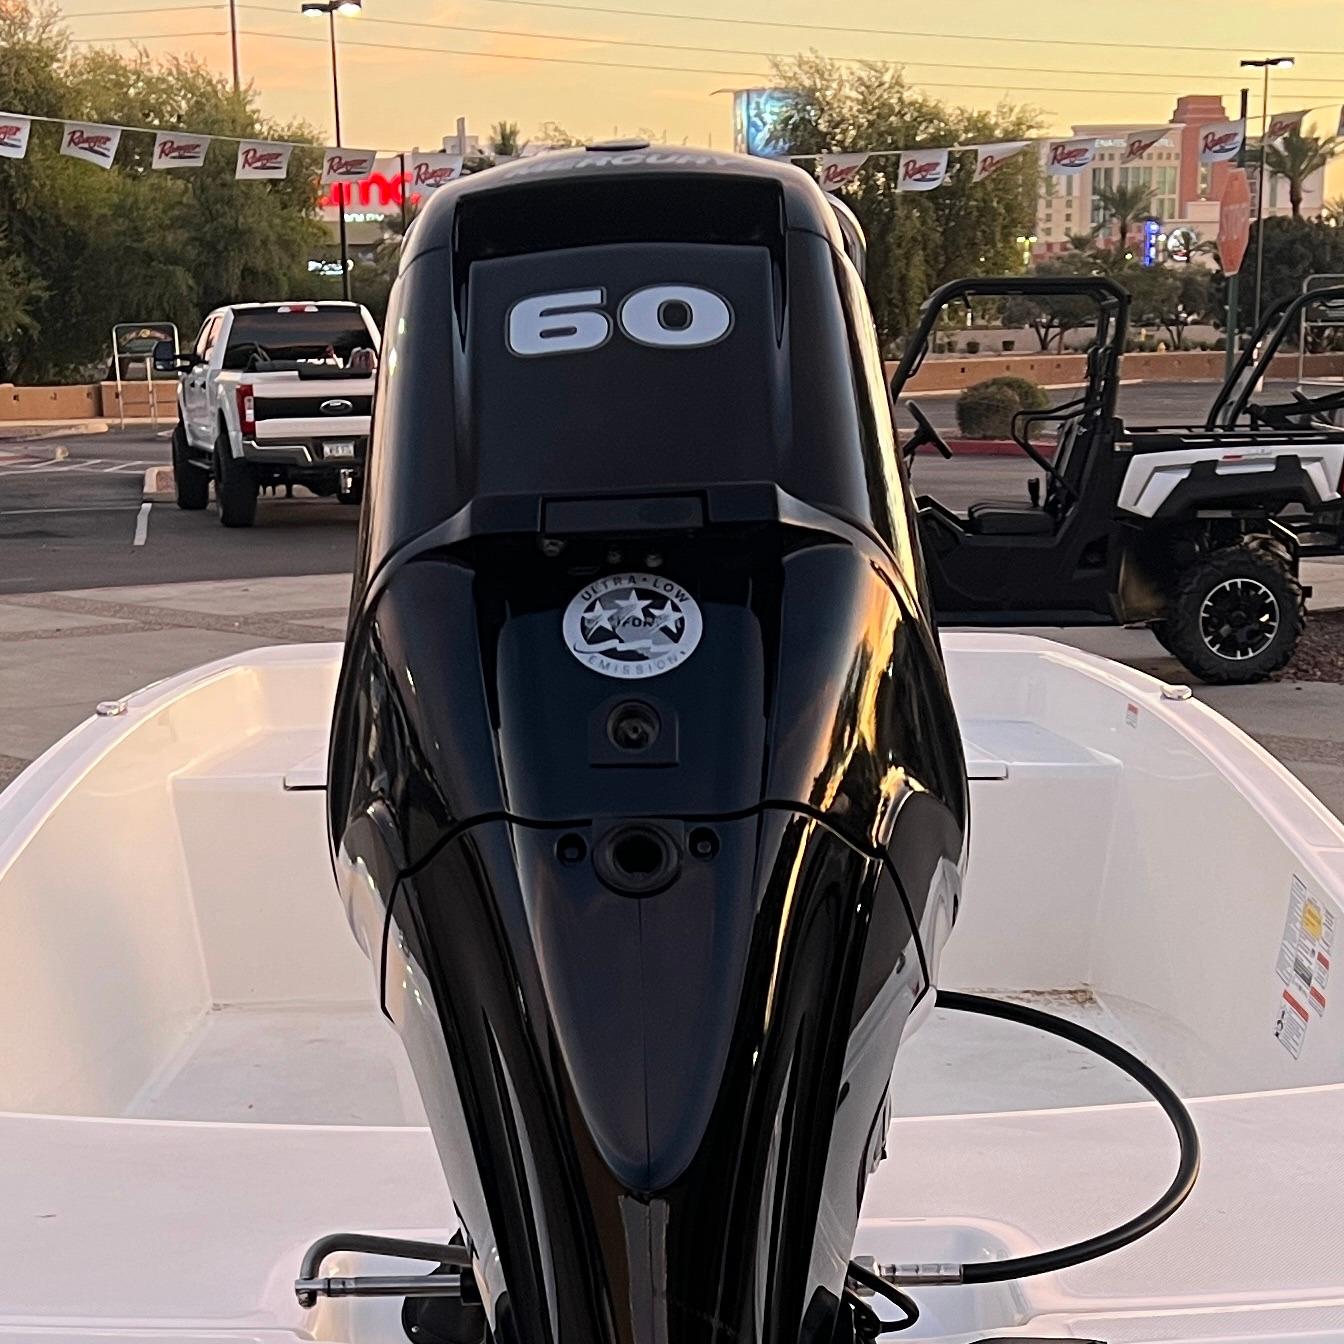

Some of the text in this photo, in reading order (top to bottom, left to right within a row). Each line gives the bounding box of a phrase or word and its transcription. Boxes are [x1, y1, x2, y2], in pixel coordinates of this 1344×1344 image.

[67, 130, 111, 149] Ranger
[159, 140, 201, 159] Ranger
[242, 148, 283, 169] Ranger
[326, 156, 369, 175] Ranger
[1051, 144, 1090, 166] Ranger
[414, 162, 455, 185] Ranger
[903, 159, 942, 181] Ranger
[506, 283, 734, 358] 60
[581, 575, 691, 603] ULTRA LOW
